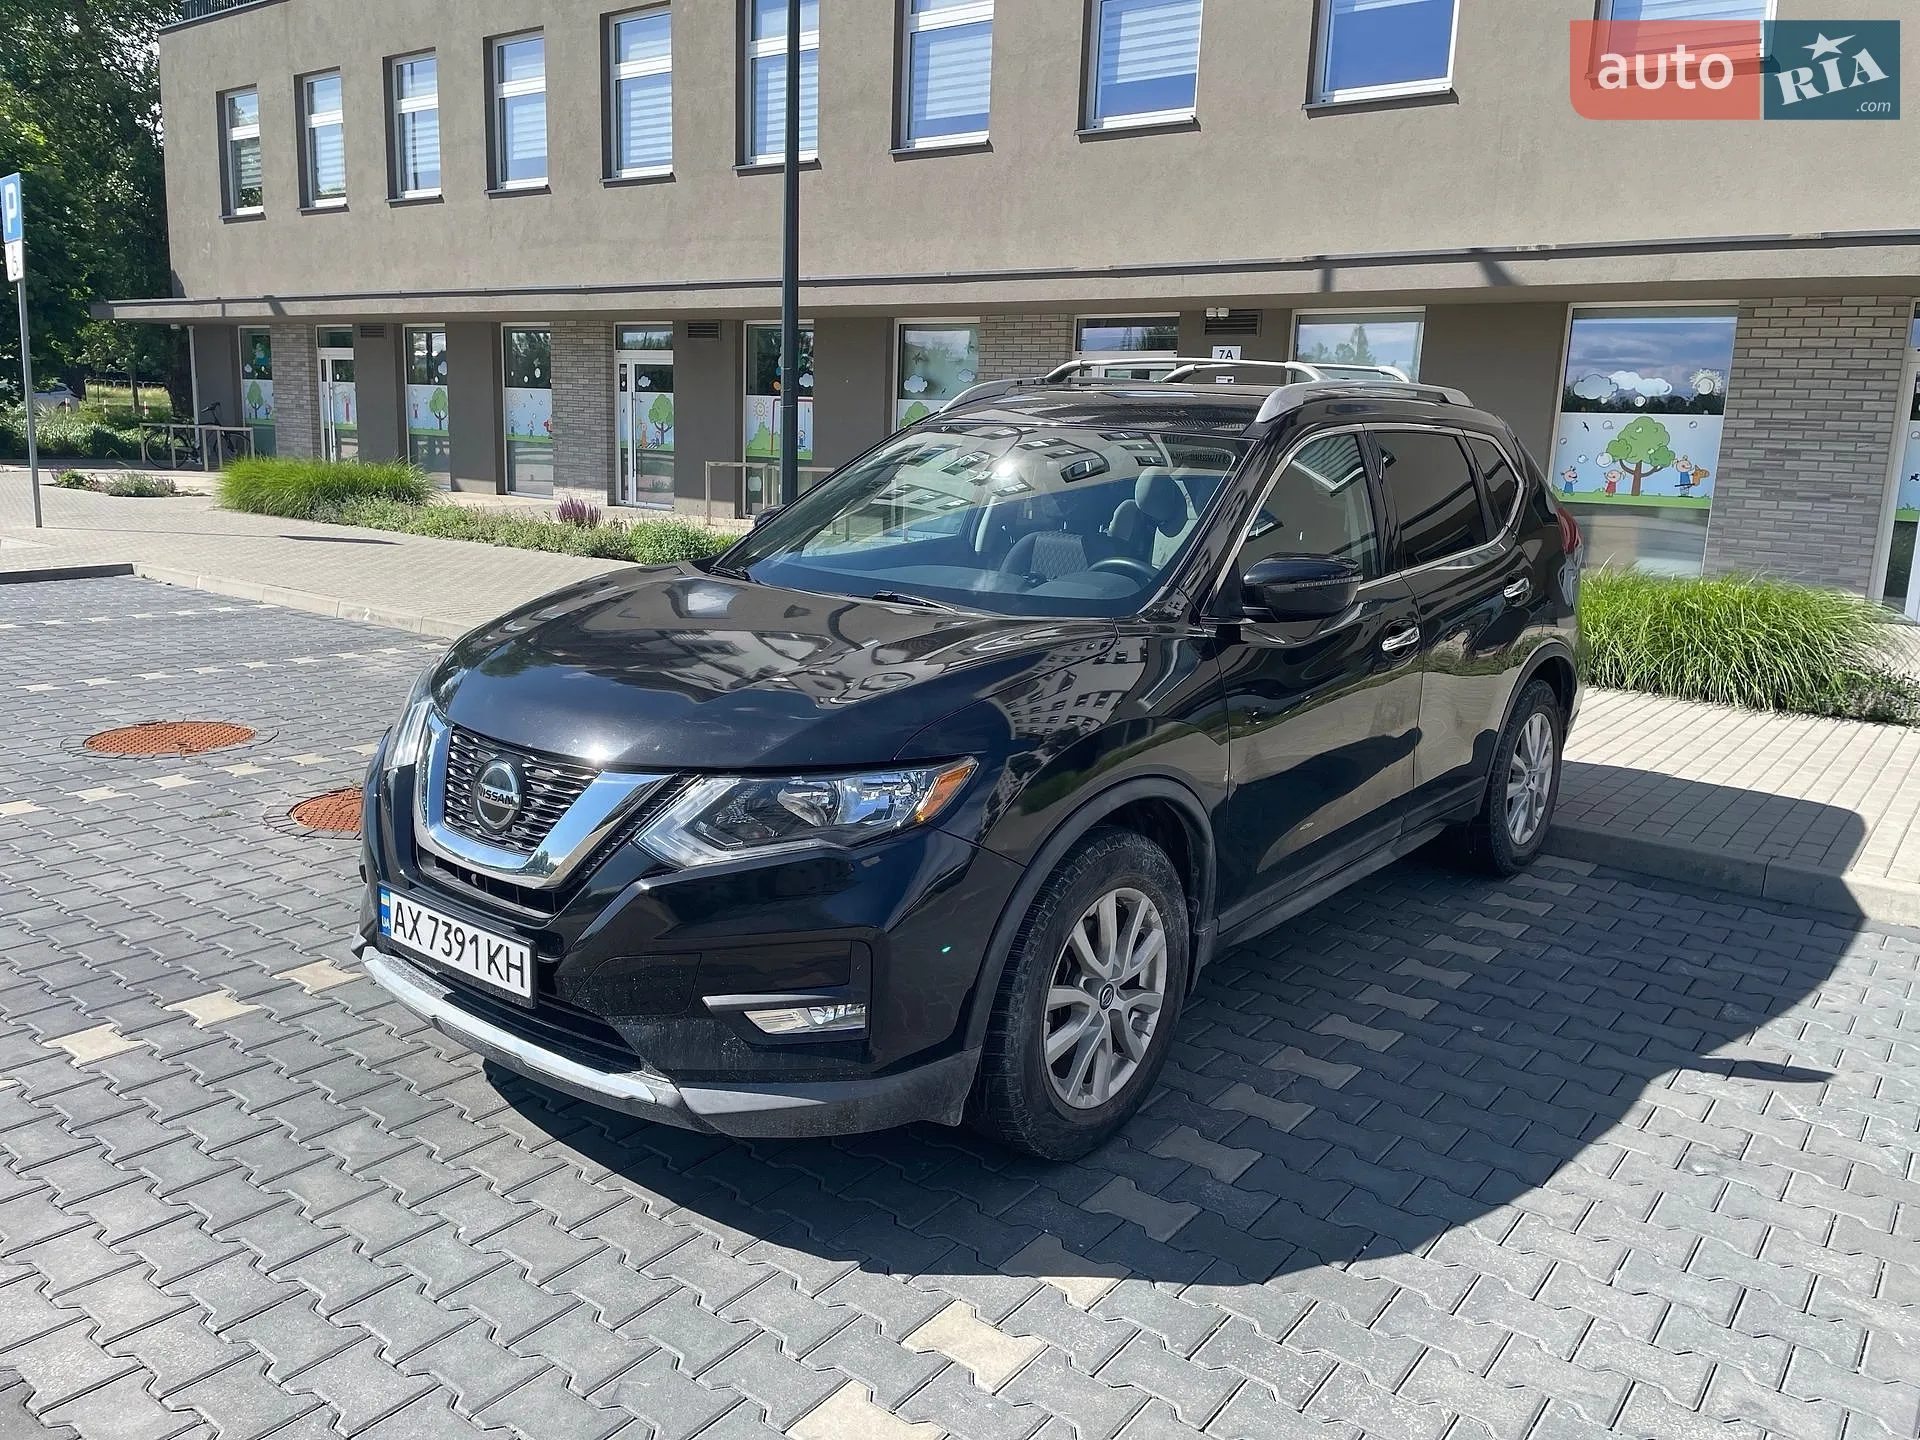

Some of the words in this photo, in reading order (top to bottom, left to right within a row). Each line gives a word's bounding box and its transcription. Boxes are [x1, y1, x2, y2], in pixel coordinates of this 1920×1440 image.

[5, 183, 17, 233] P
[1219, 349, 1234, 360] 7A
[478, 786, 514, 805] NISSAN
[381, 916, 391, 930] UA
[393, 901, 422, 946] AX
[427, 914, 479, 971] 7391
[487, 938, 525, 988] KH
